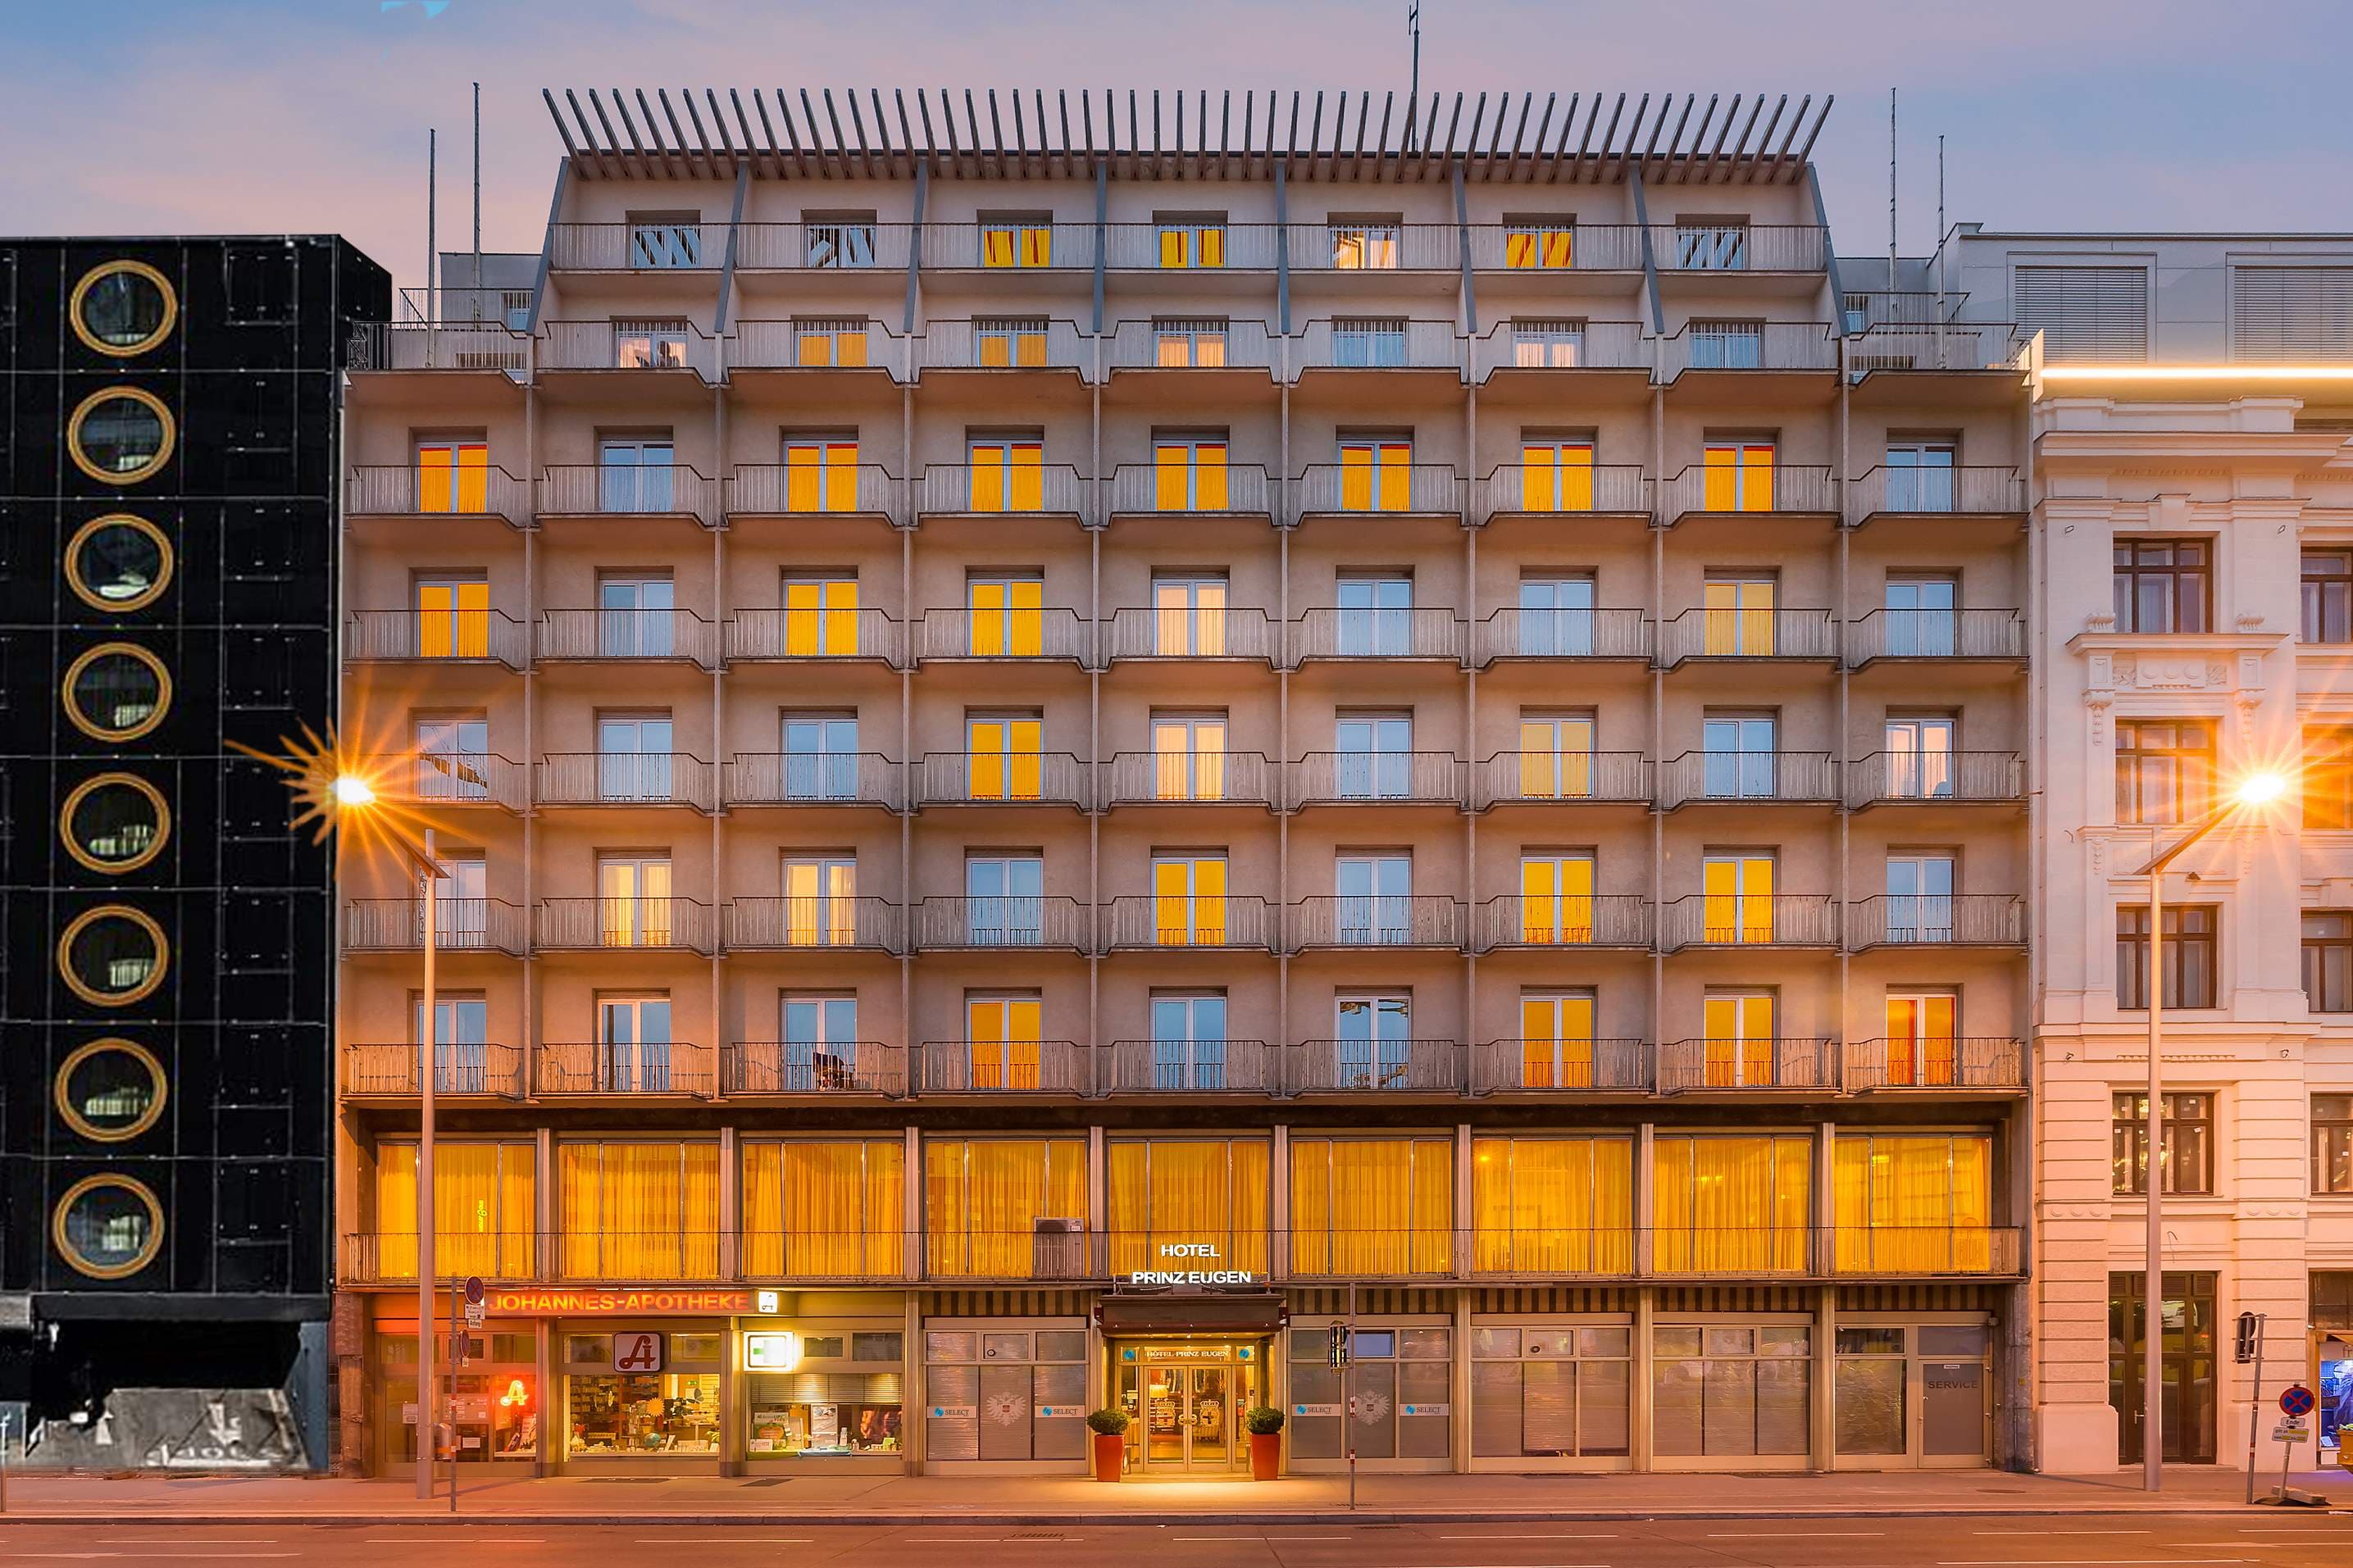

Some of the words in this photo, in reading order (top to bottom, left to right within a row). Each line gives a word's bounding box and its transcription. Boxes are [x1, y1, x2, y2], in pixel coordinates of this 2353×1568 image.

[1161, 1244, 1220, 1257] HOTEL
[1132, 1271, 1186, 1284] PRINZ
[1189, 1270, 1251, 1284] EUGEN
[488, 1293, 749, 1311] JOHANNES-APOTHEKE
[1927, 1380, 1978, 1389] SERVICE
